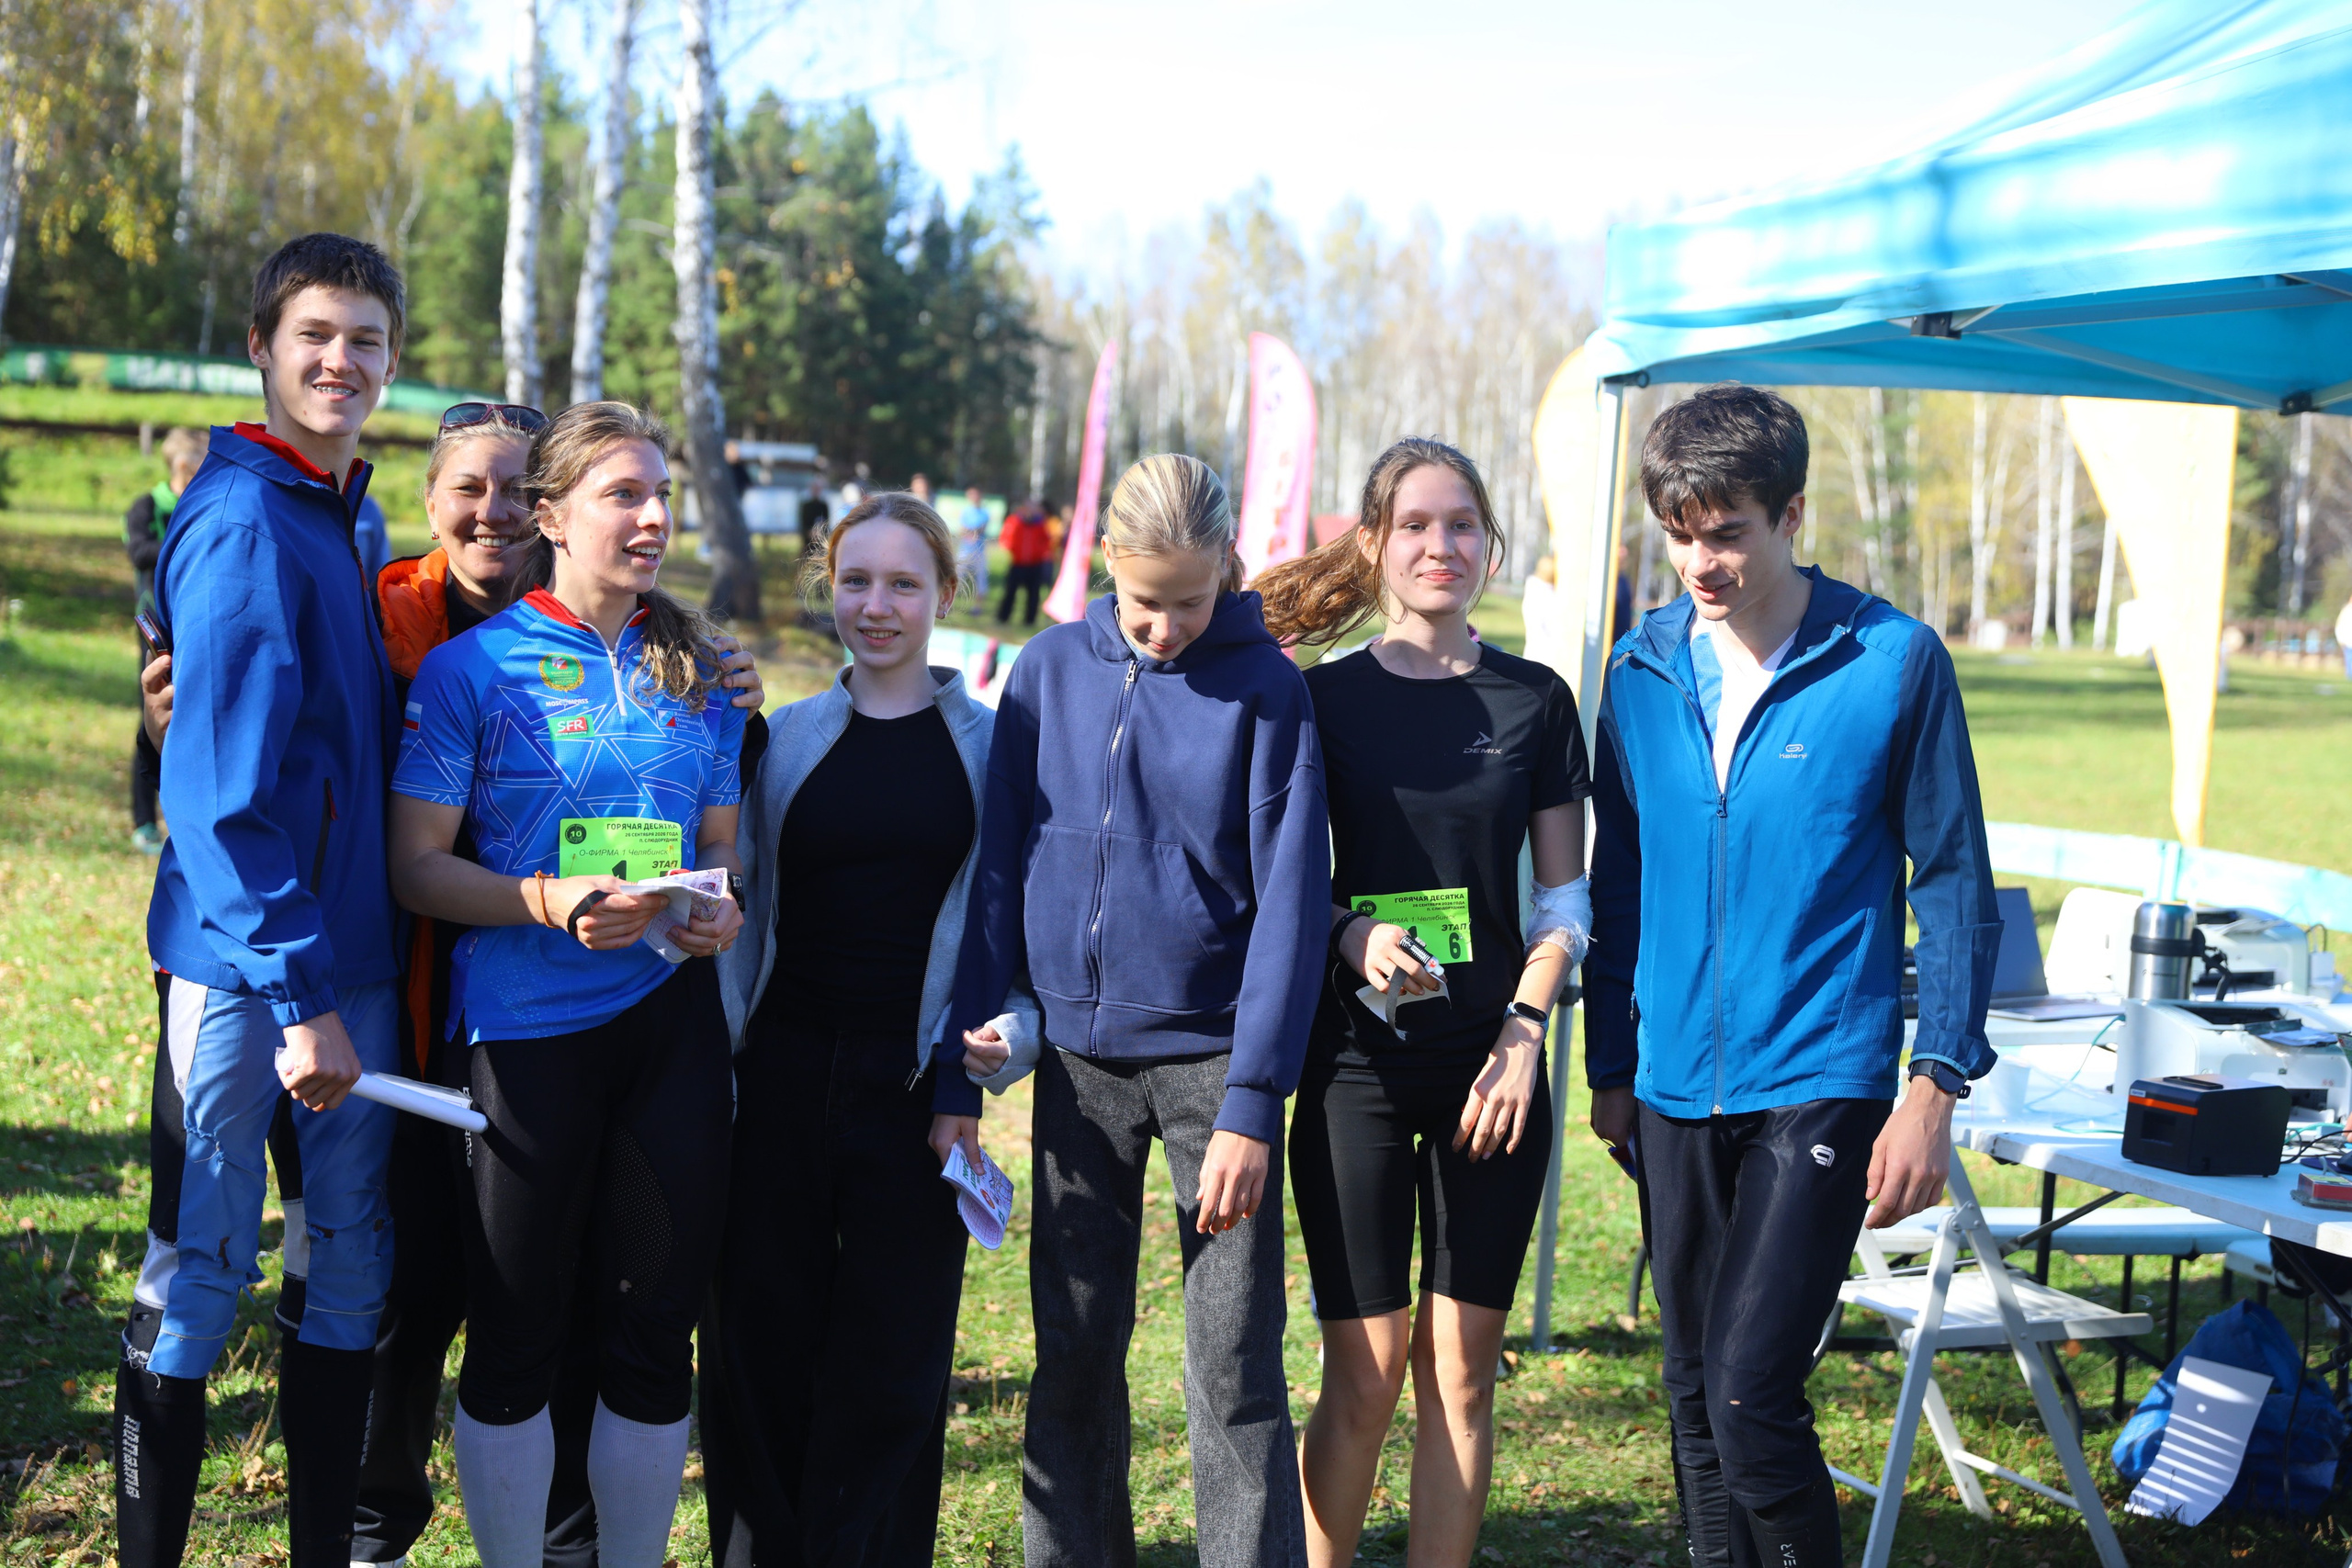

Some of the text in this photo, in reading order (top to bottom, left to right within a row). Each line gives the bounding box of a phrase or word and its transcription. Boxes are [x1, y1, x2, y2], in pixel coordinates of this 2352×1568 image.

[557, 719, 585, 732] SFR
[643, 822, 678, 830] ДЕСЯТКА
[628, 848, 669, 856] Челябинск
[651, 860, 679, 869] ЭТАП
[1394, 893, 1465, 904] ГОРЯЧАЯ ДЕСЯТКА
[1417, 914, 1456, 922] Челябинск
[1441, 922, 1467, 932] ЭТАП
[1448, 931, 1462, 960] 6
[122, 1415, 141, 1499] noname
